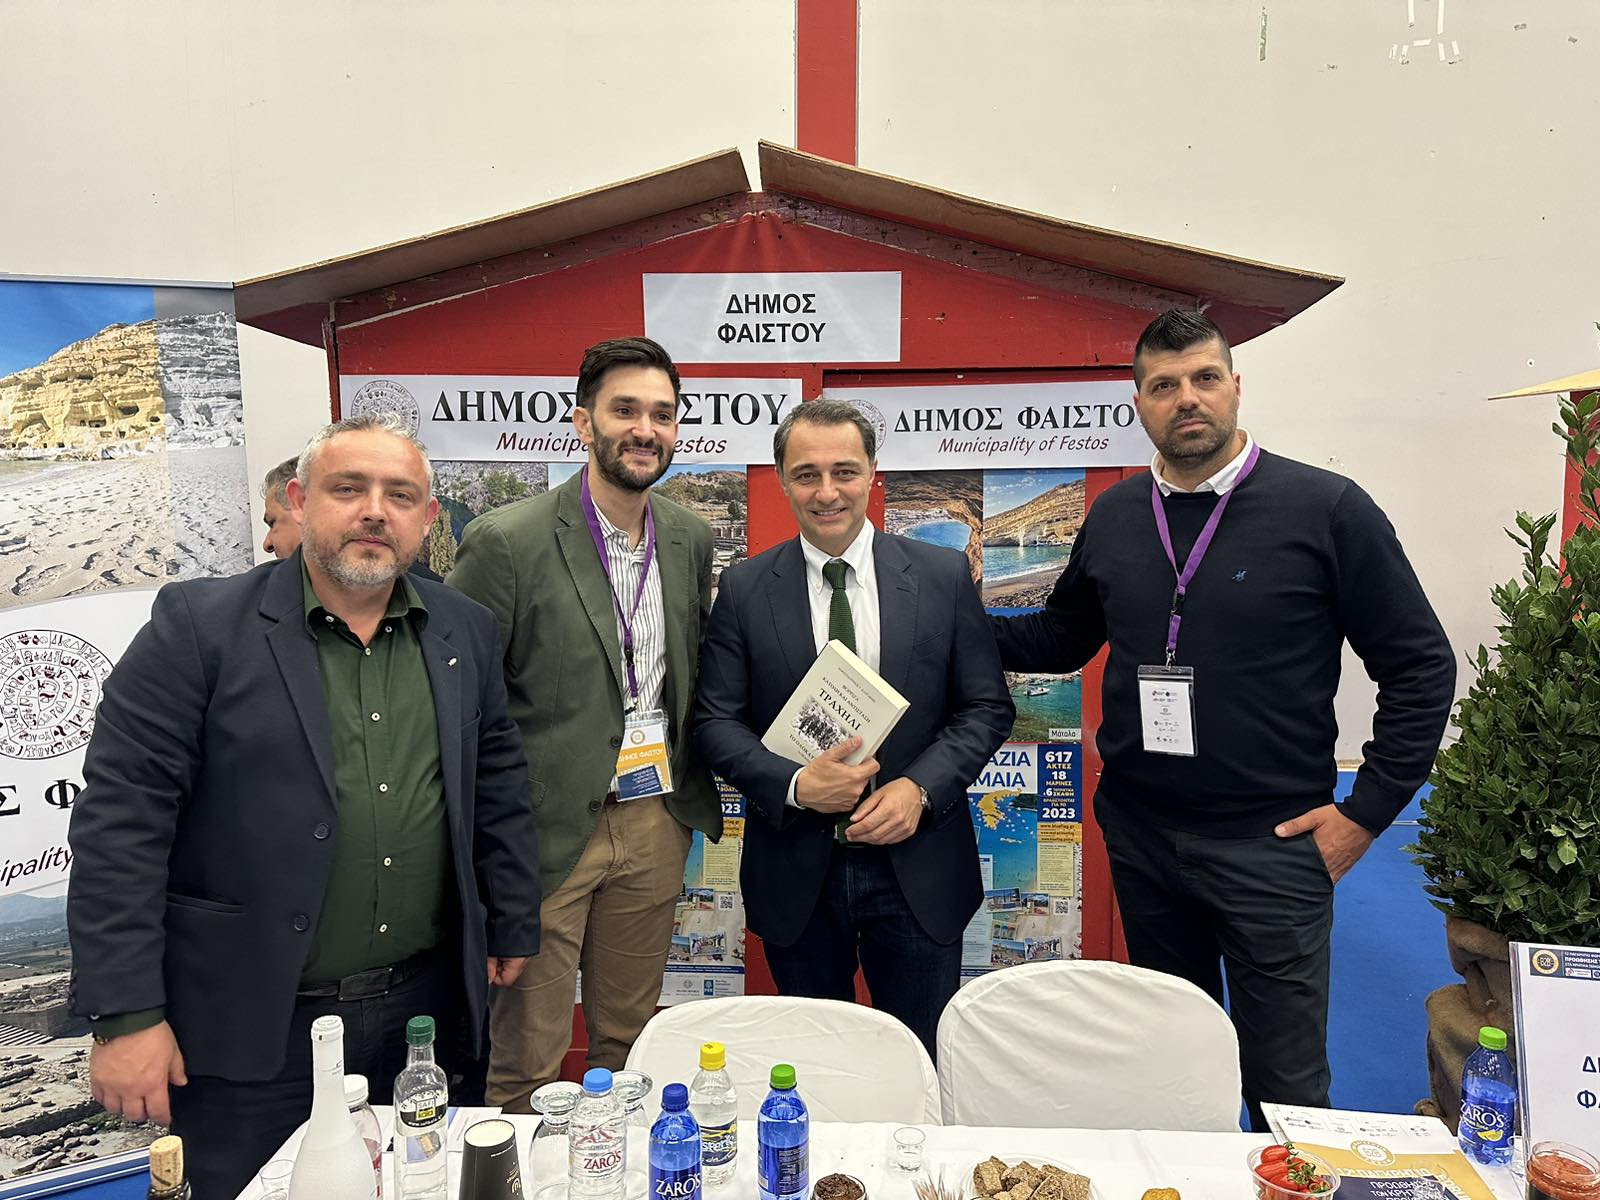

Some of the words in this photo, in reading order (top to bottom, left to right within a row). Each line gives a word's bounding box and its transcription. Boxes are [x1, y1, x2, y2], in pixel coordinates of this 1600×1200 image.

[725, 293, 816, 314] ΔΗΜΟΣ
[717, 322, 826, 343] ΦΑΙΣΤΟΥ
[431, 389, 577, 424] ΔΗΜΟΣ
[678, 392, 788, 426] ΣΤΟΥ
[894, 407, 1003, 433] ΔΗΜΟΣ
[1017, 403, 1136, 430] ΦΑΙΣΤΟ
[495, 432, 589, 457] Municipa
[673, 435, 727, 454] estos
[938, 434, 1036, 457] Municipality
[1038, 435, 1059, 452] of
[1059, 434, 1110, 451] Festos
[819, 687, 861, 731] ΤΡΑΧΗΛΙ
[1045, 751, 1073, 763] 617
[973, 771, 1026, 787] ΜΑΙΑ
[1051, 771, 1066, 780] 18
[1046, 788, 1053, 796] 6
[1042, 808, 1076, 819] 2023
[0, 847, 74, 887] ipality
